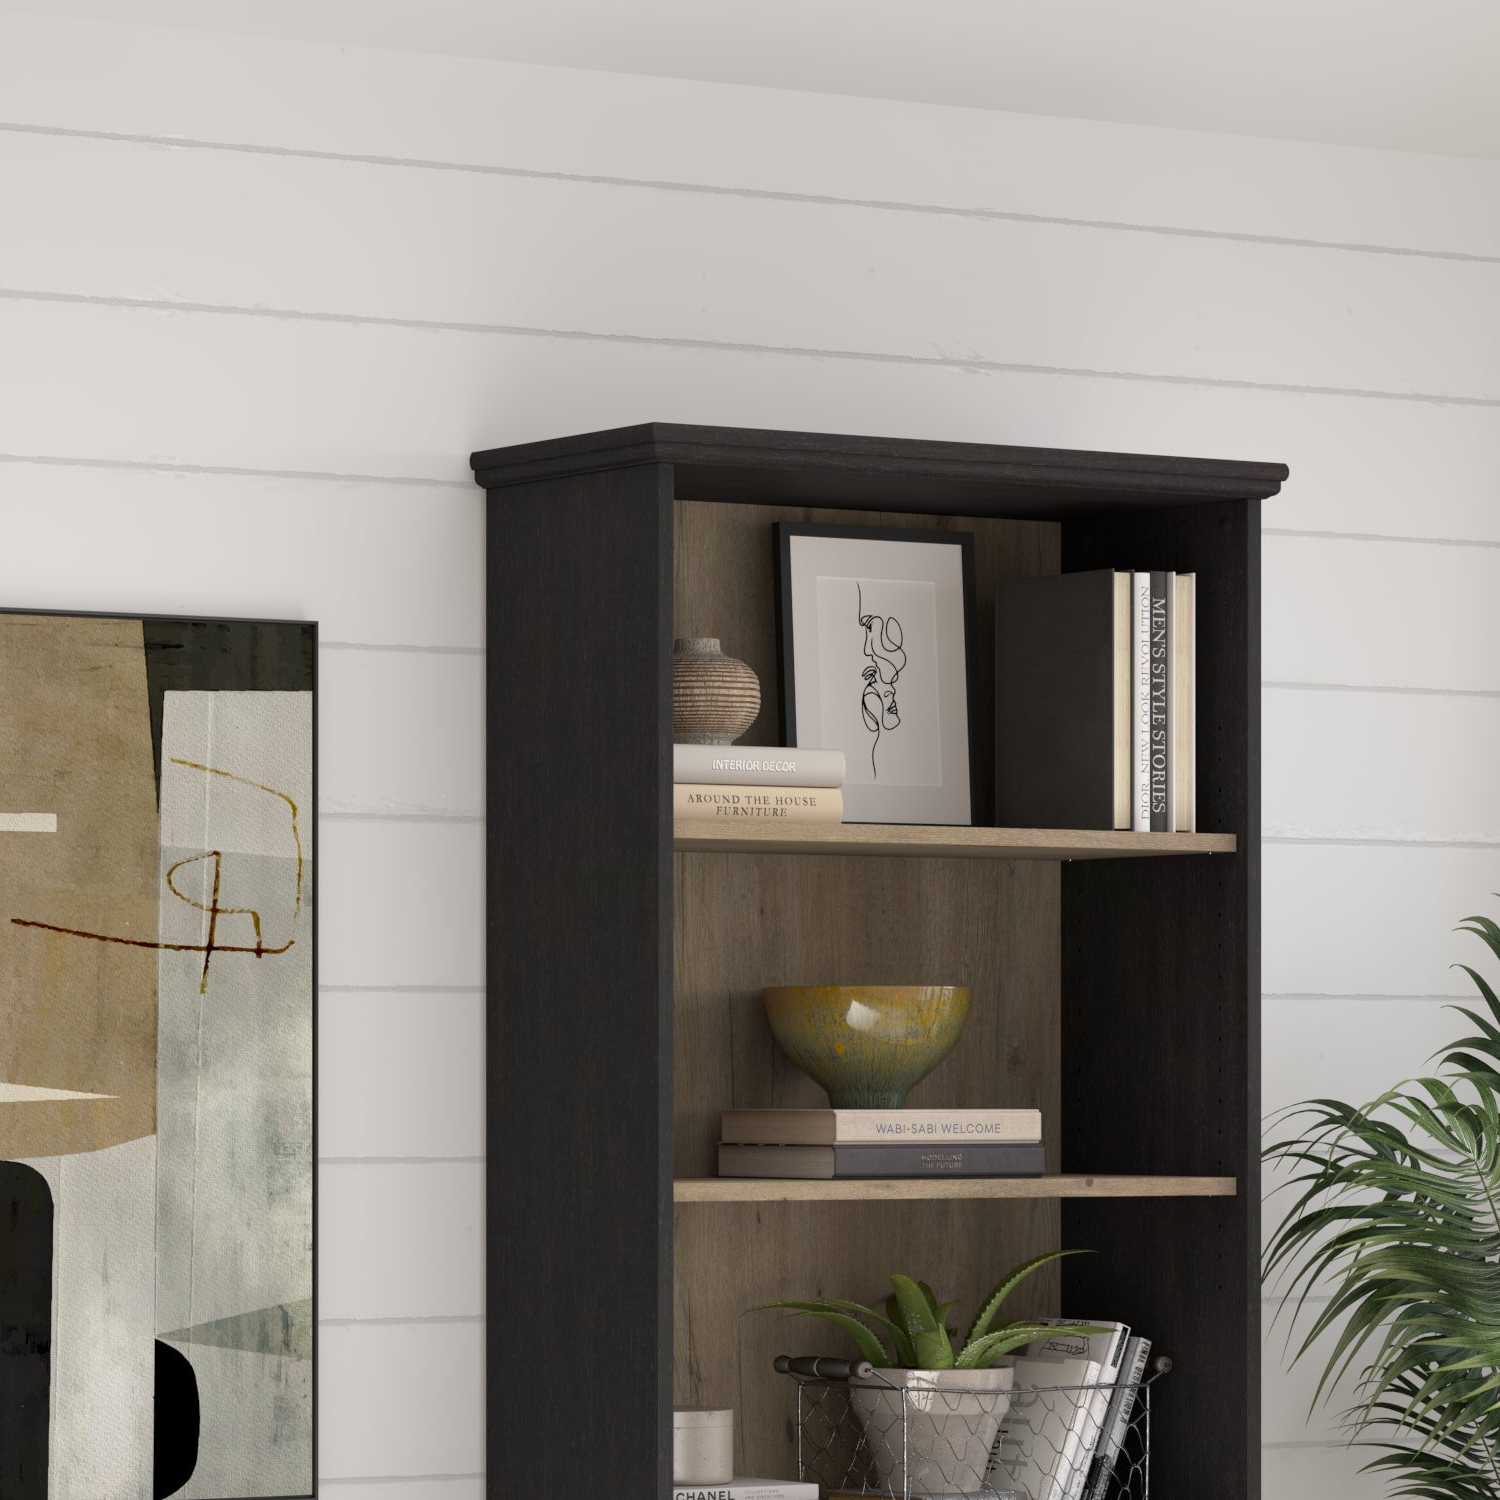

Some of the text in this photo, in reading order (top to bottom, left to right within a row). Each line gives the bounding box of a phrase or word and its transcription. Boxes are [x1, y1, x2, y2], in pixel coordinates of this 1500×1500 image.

[1141, 586, 1150, 686] REVOLUTION
[1141, 691, 1150, 733] LOOK
[1152, 597, 1166, 813] MEN'S STYLE STORIES
[712, 759, 797, 773] INTERIOR DECOR
[1141, 739, 1150, 774] NEW
[687, 793, 818, 807] AROUND THE HOUSE
[716, 806, 788, 817] FURNITURE
[875, 1123, 1002, 1135] WABI-SABI WELCOME
